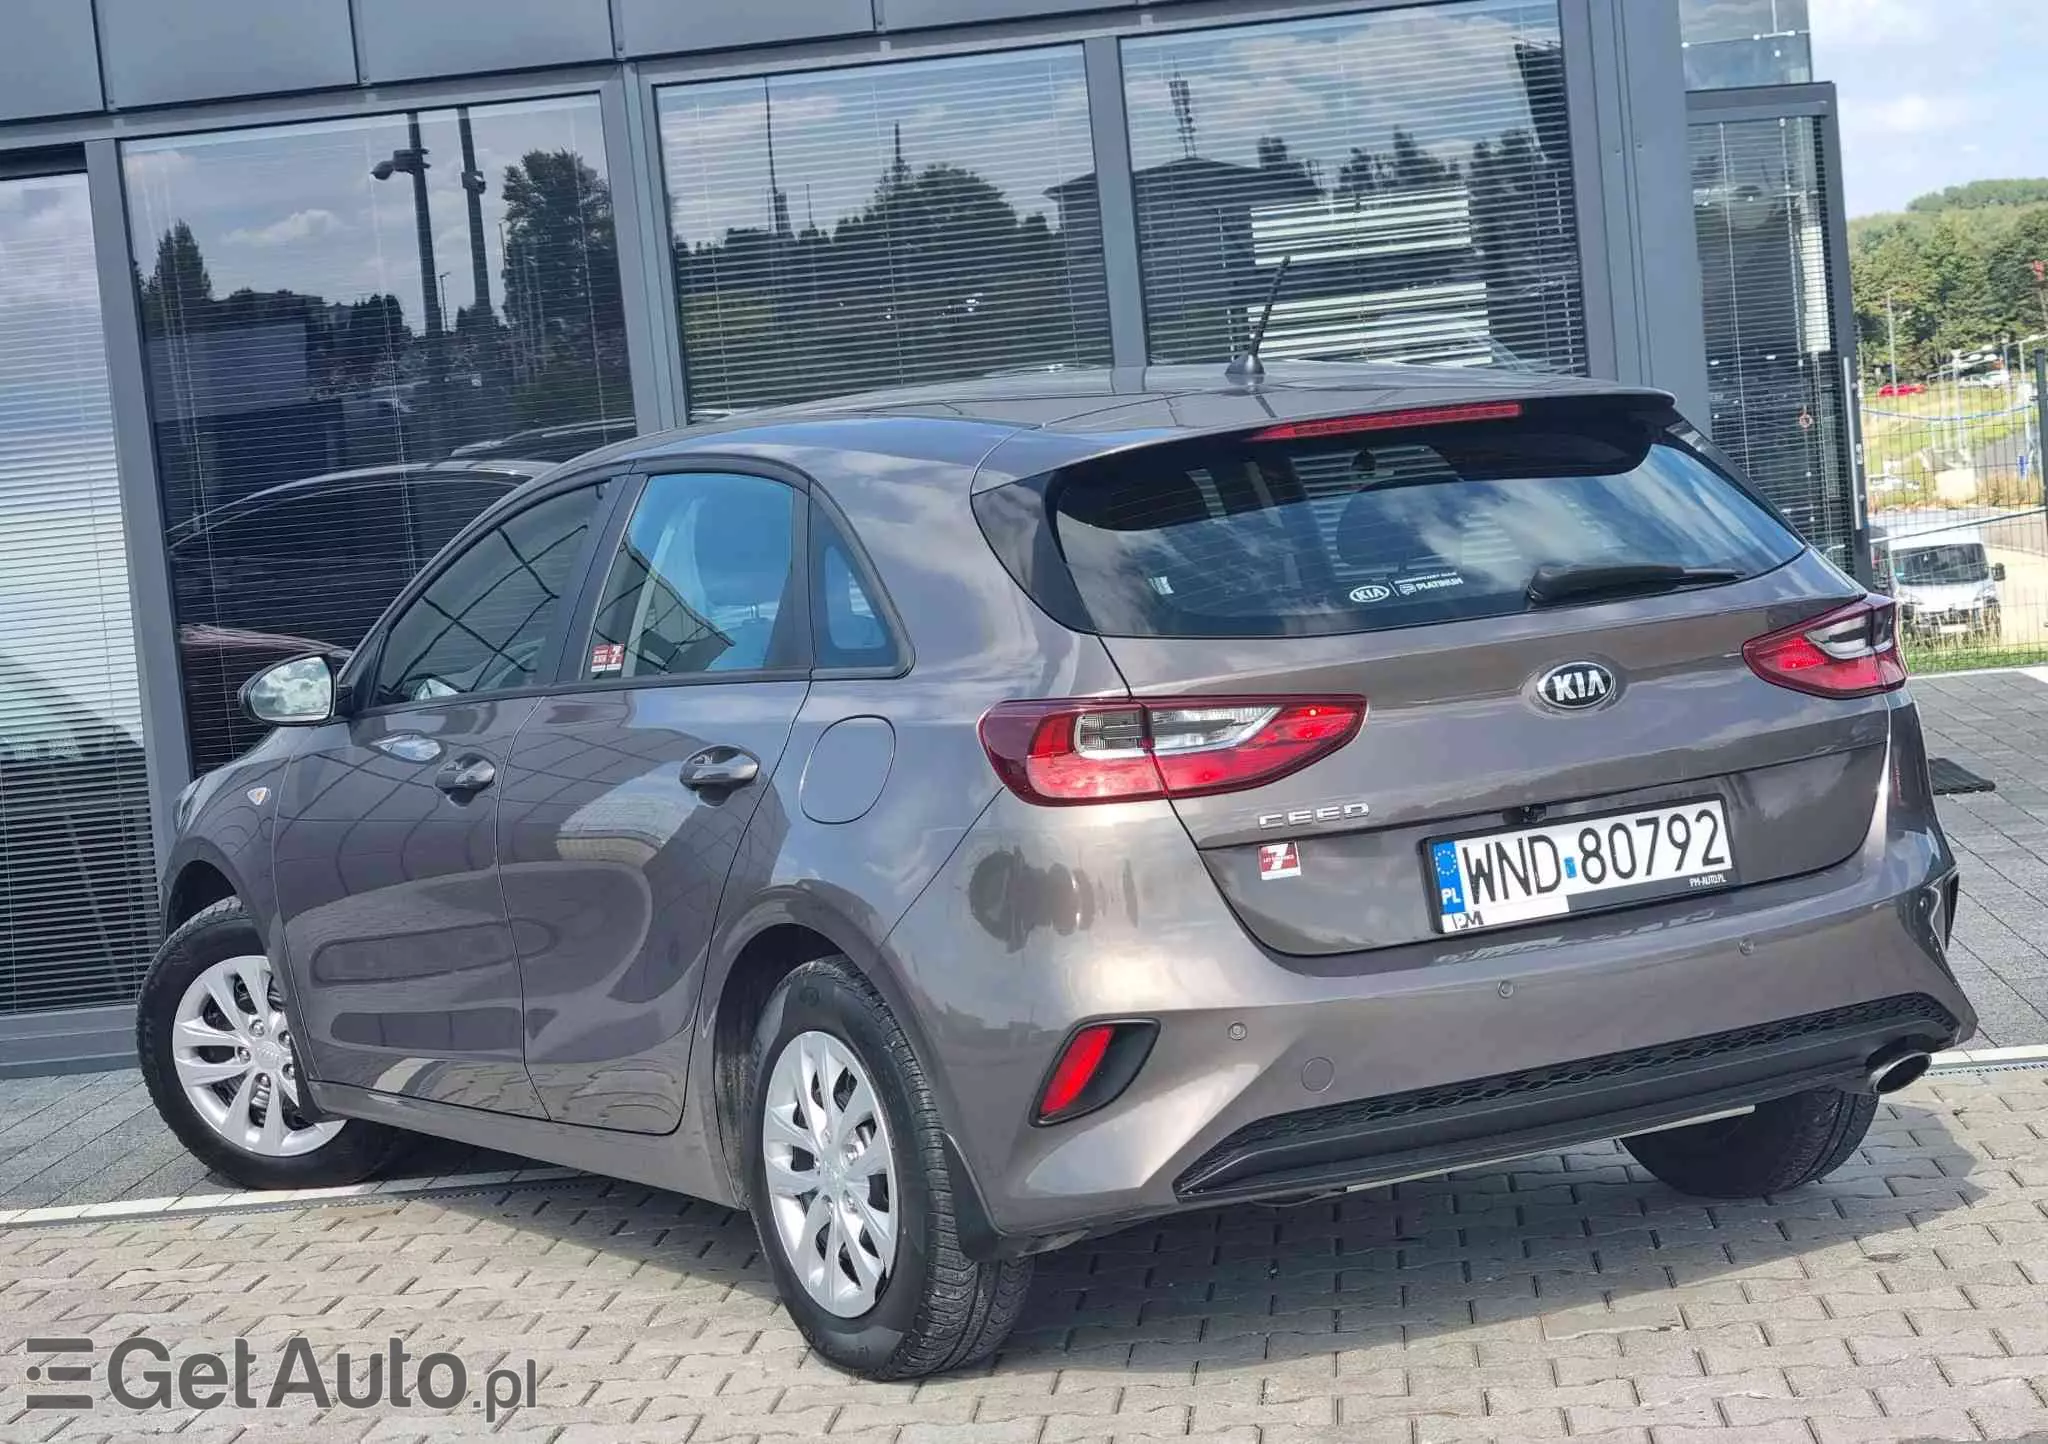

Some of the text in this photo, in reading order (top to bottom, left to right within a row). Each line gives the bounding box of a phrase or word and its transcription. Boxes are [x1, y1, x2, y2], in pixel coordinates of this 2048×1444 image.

[1355, 588, 1384, 600] KIA
[1552, 669, 1606, 701] KIA
[1259, 802, 1369, 829] CEED
[1462, 808, 1726, 905] WND 80792
[1441, 887, 1461, 905] PL
